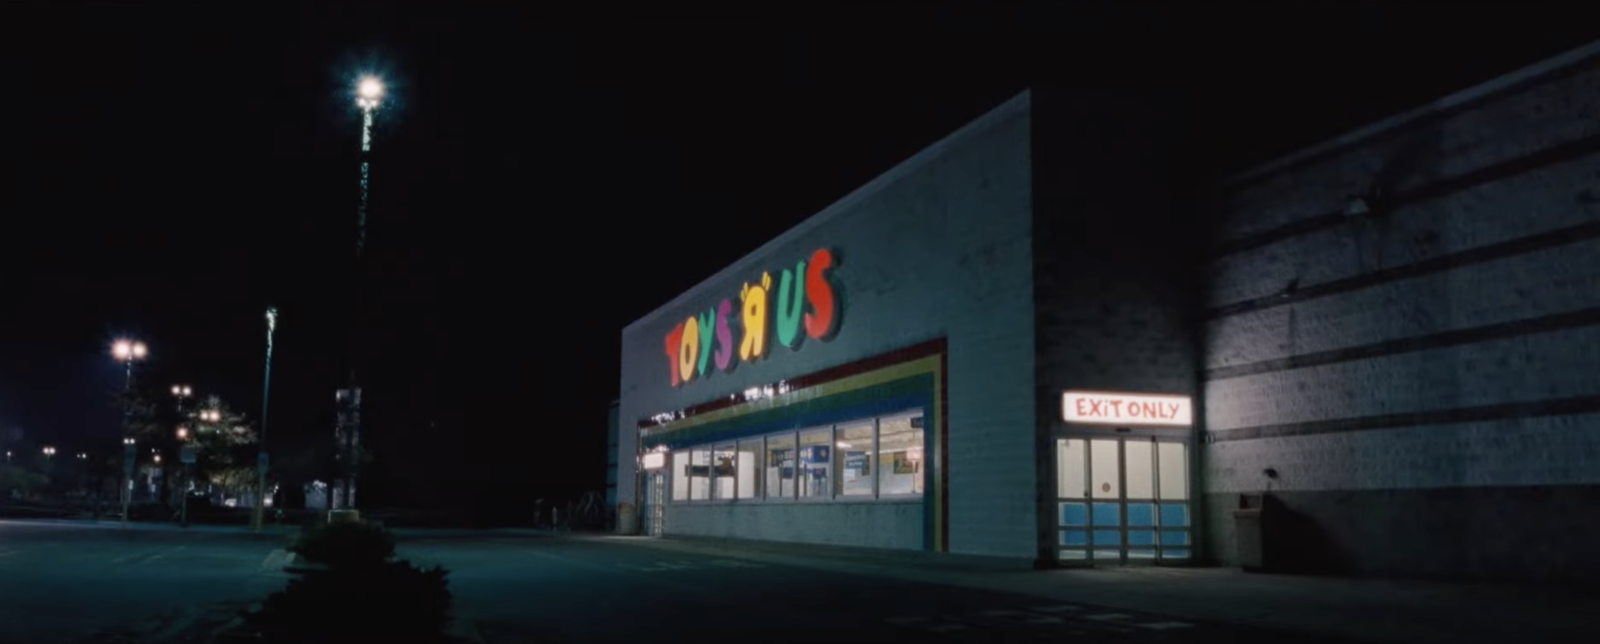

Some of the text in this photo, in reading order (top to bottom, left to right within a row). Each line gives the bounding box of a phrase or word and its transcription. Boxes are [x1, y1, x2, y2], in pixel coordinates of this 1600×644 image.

[665, 299, 733, 388] TOYS
[777, 248, 834, 347] US
[1127, 400, 1180, 420] ONLY
